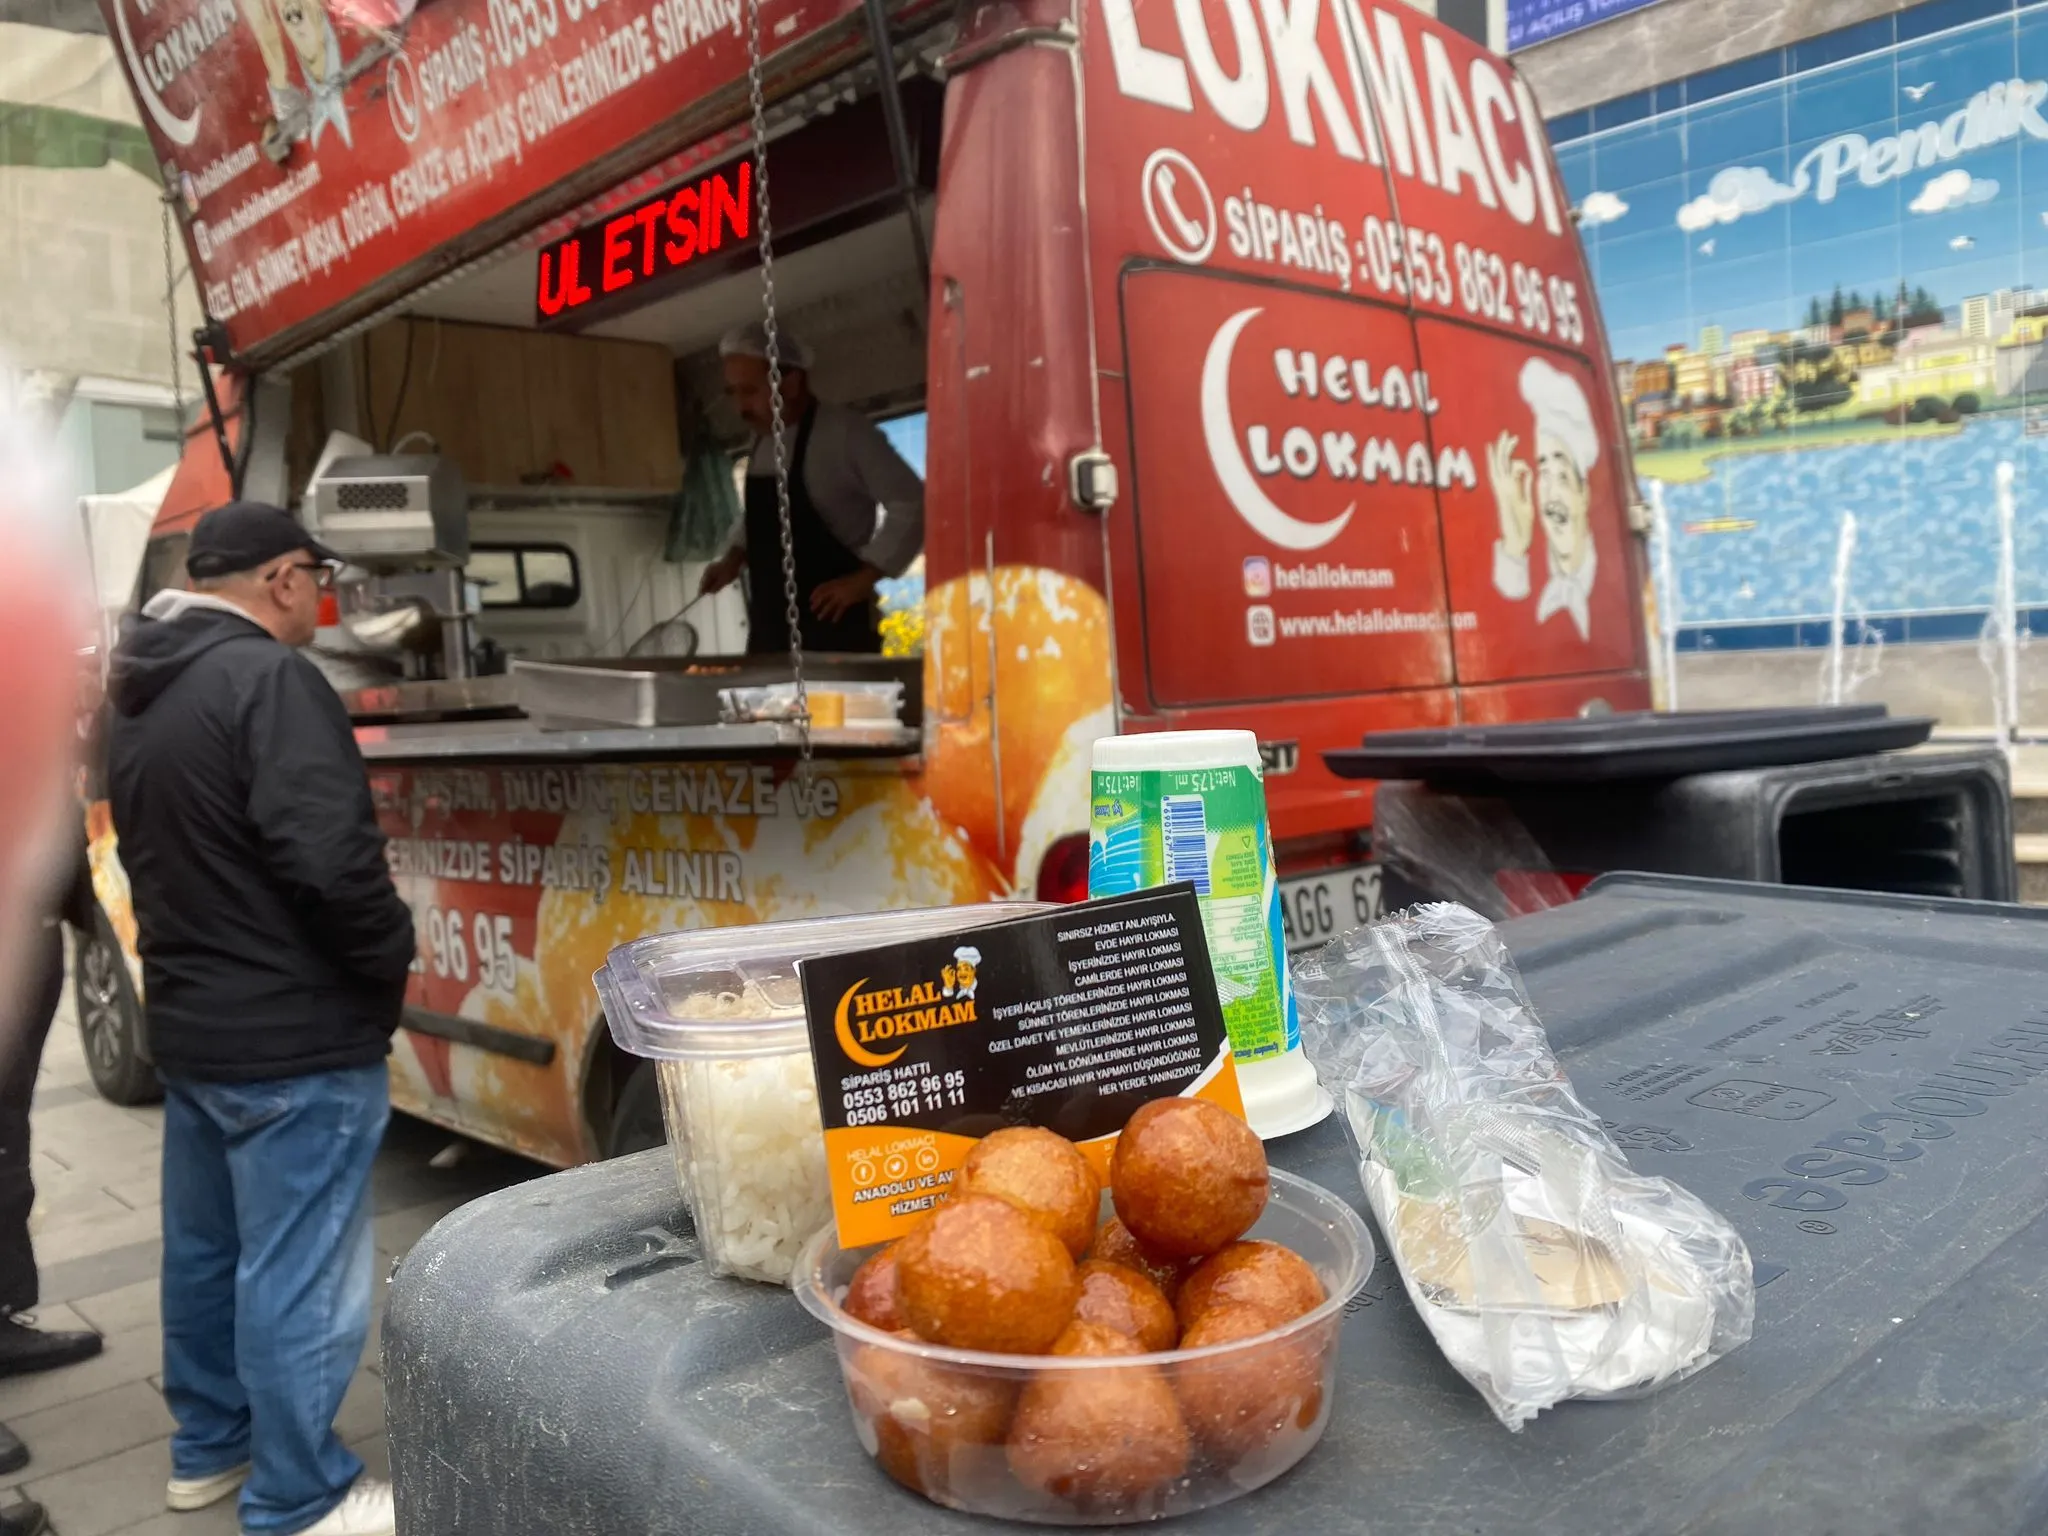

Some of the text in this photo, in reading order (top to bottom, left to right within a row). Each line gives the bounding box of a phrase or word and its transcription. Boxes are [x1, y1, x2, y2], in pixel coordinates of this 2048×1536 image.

[144, 0, 237, 93] LOKMAM
[1102, 0, 1563, 236] LOKMACI
[1795, 77, 2048, 204] Pendik
[1224, 187, 1351, 292] SİPARİŞ
[1453, 242, 1514, 323] 862
[1512, 262, 1550, 334] 96
[1548, 275, 1584, 345] 95
[1273, 347, 1440, 415] HELAL
[1246, 424, 1478, 490] LOKMAM
[1274, 562, 1394, 589] helallokmam
[1279, 607, 1478, 637] www.helallokmaci.om
[627, 763, 778, 818] CENAZE
[499, 833, 612, 905] SİPARİŞ
[620, 848, 746, 905] ALINIR
[427, 905, 517, 994] 96 95
[1057, 926, 1093, 943] SINIRSIZ
[1094, 920, 1124, 936] HİZMET
[1094, 927, 1179, 952] EVDE HAYIR LOKMASI
[1068, 942, 1182, 974] İŞYERİNİZDE HAYIR LOKMASI
[1074, 956, 1185, 988] CAMİLERDE HAYIR LOKMASI
[853, 981, 942, 1017] HELAL
[992, 971, 1187, 1021] İŞYERİ AÇILIŞ TÖRENLERİNİZDE HAYIR LOKMASI
[1018, 986, 1190, 1032] SÜNNET TÖRENLERİNİZDE HAYIR LOKMASI
[856, 1000, 978, 1043] LOKMAM
[988, 1001, 1193, 1054] ÖZEL DAVET VE YEMEKLERİNİZDE HAYIR LOKMASI
[1055, 1016, 1195, 1057] MEVLÜTLERİNİZDE HAYIR LOKMASI
[841, 1061, 931, 1091] SİPARİŞ HATTI
[1011, 1047, 1201, 1100] VE KISACASI HAYIR YAPMAYI DÜŞÜNDÜĞÜNÜZ
[1026, 1032, 1198, 1079] ÖLÜM YIL DÖNÜMLERİNDE HAYIR LOKMASI
[843, 1069, 965, 1110] 0553 862 96 95
[846, 1086, 965, 1127] 0506 101 11 11
[1099, 1081, 1119, 1096] HER
[1118, 1075, 1148, 1091] YERDE
[846, 1145, 883, 1162] HELAL
[853, 1178, 916, 1205] ANADOLU
[917, 1173, 935, 1189] VE
[890, 1193, 937, 1217] HİZMET
